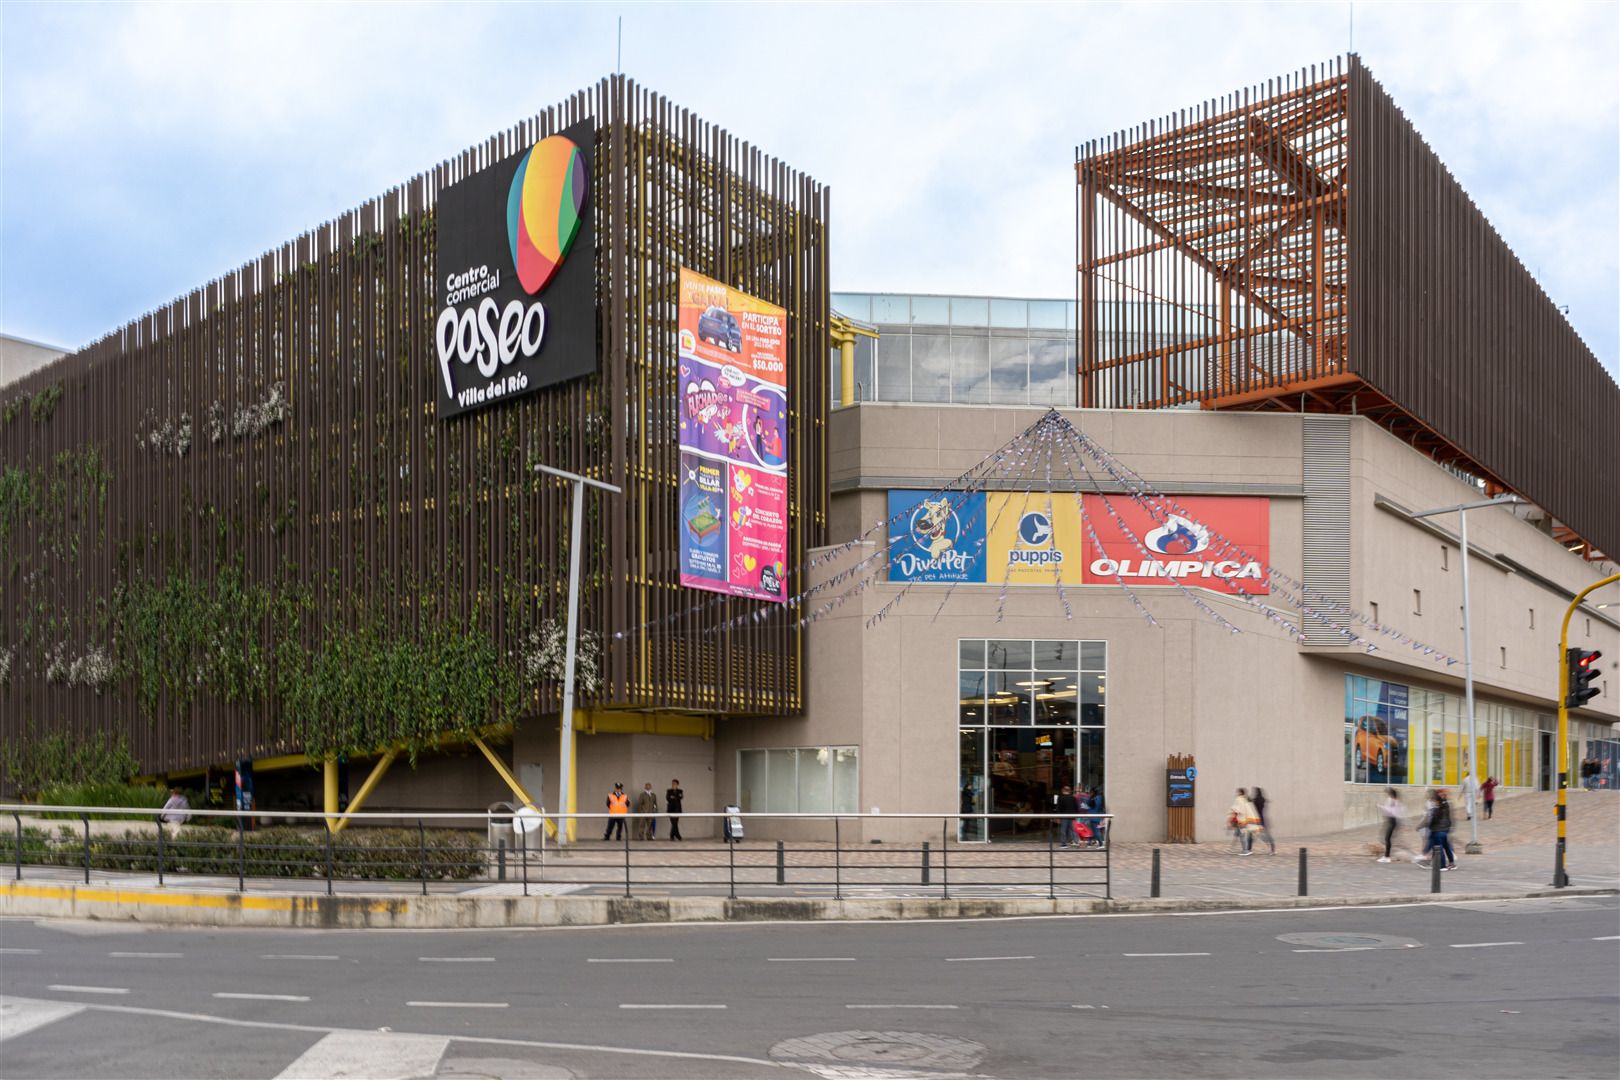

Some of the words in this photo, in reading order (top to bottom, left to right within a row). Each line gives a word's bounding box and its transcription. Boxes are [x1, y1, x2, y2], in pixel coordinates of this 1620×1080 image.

[446, 264, 488, 291] Centro
[446, 268, 500, 306] comercial
[743, 312, 779, 326] PARTICIPA
[756, 324, 782, 336] SORTEO
[753, 358, 784, 372] $50.000
[458, 382, 486, 408] Villa
[486, 378, 506, 399] del
[508, 370, 528, 392] Río
[893, 549, 974, 577] DiverPet
[1009, 547, 1063, 566] puppis
[1089, 557, 1263, 579] OLIMPICA
